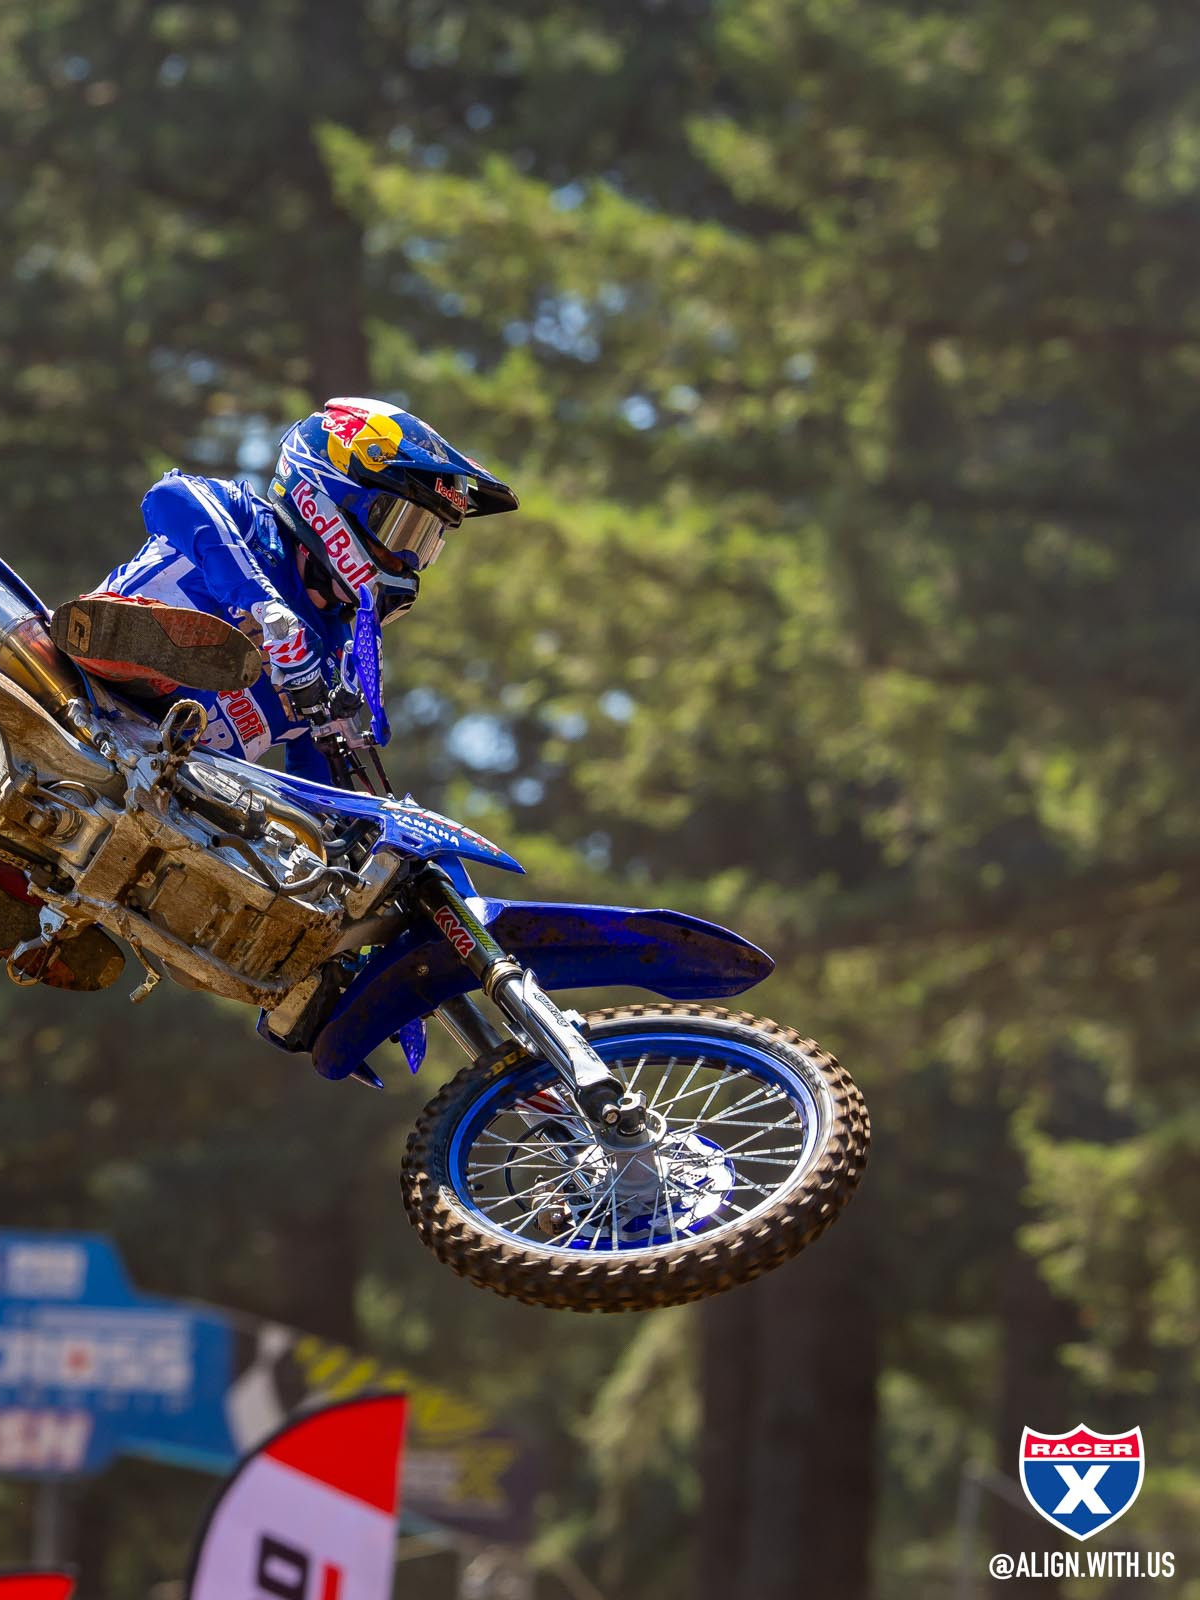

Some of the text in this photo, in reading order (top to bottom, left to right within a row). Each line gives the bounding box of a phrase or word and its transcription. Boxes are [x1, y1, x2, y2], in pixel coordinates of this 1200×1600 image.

[291, 480, 379, 591] Red Bull
[391, 812, 459, 847] YAMAHA
